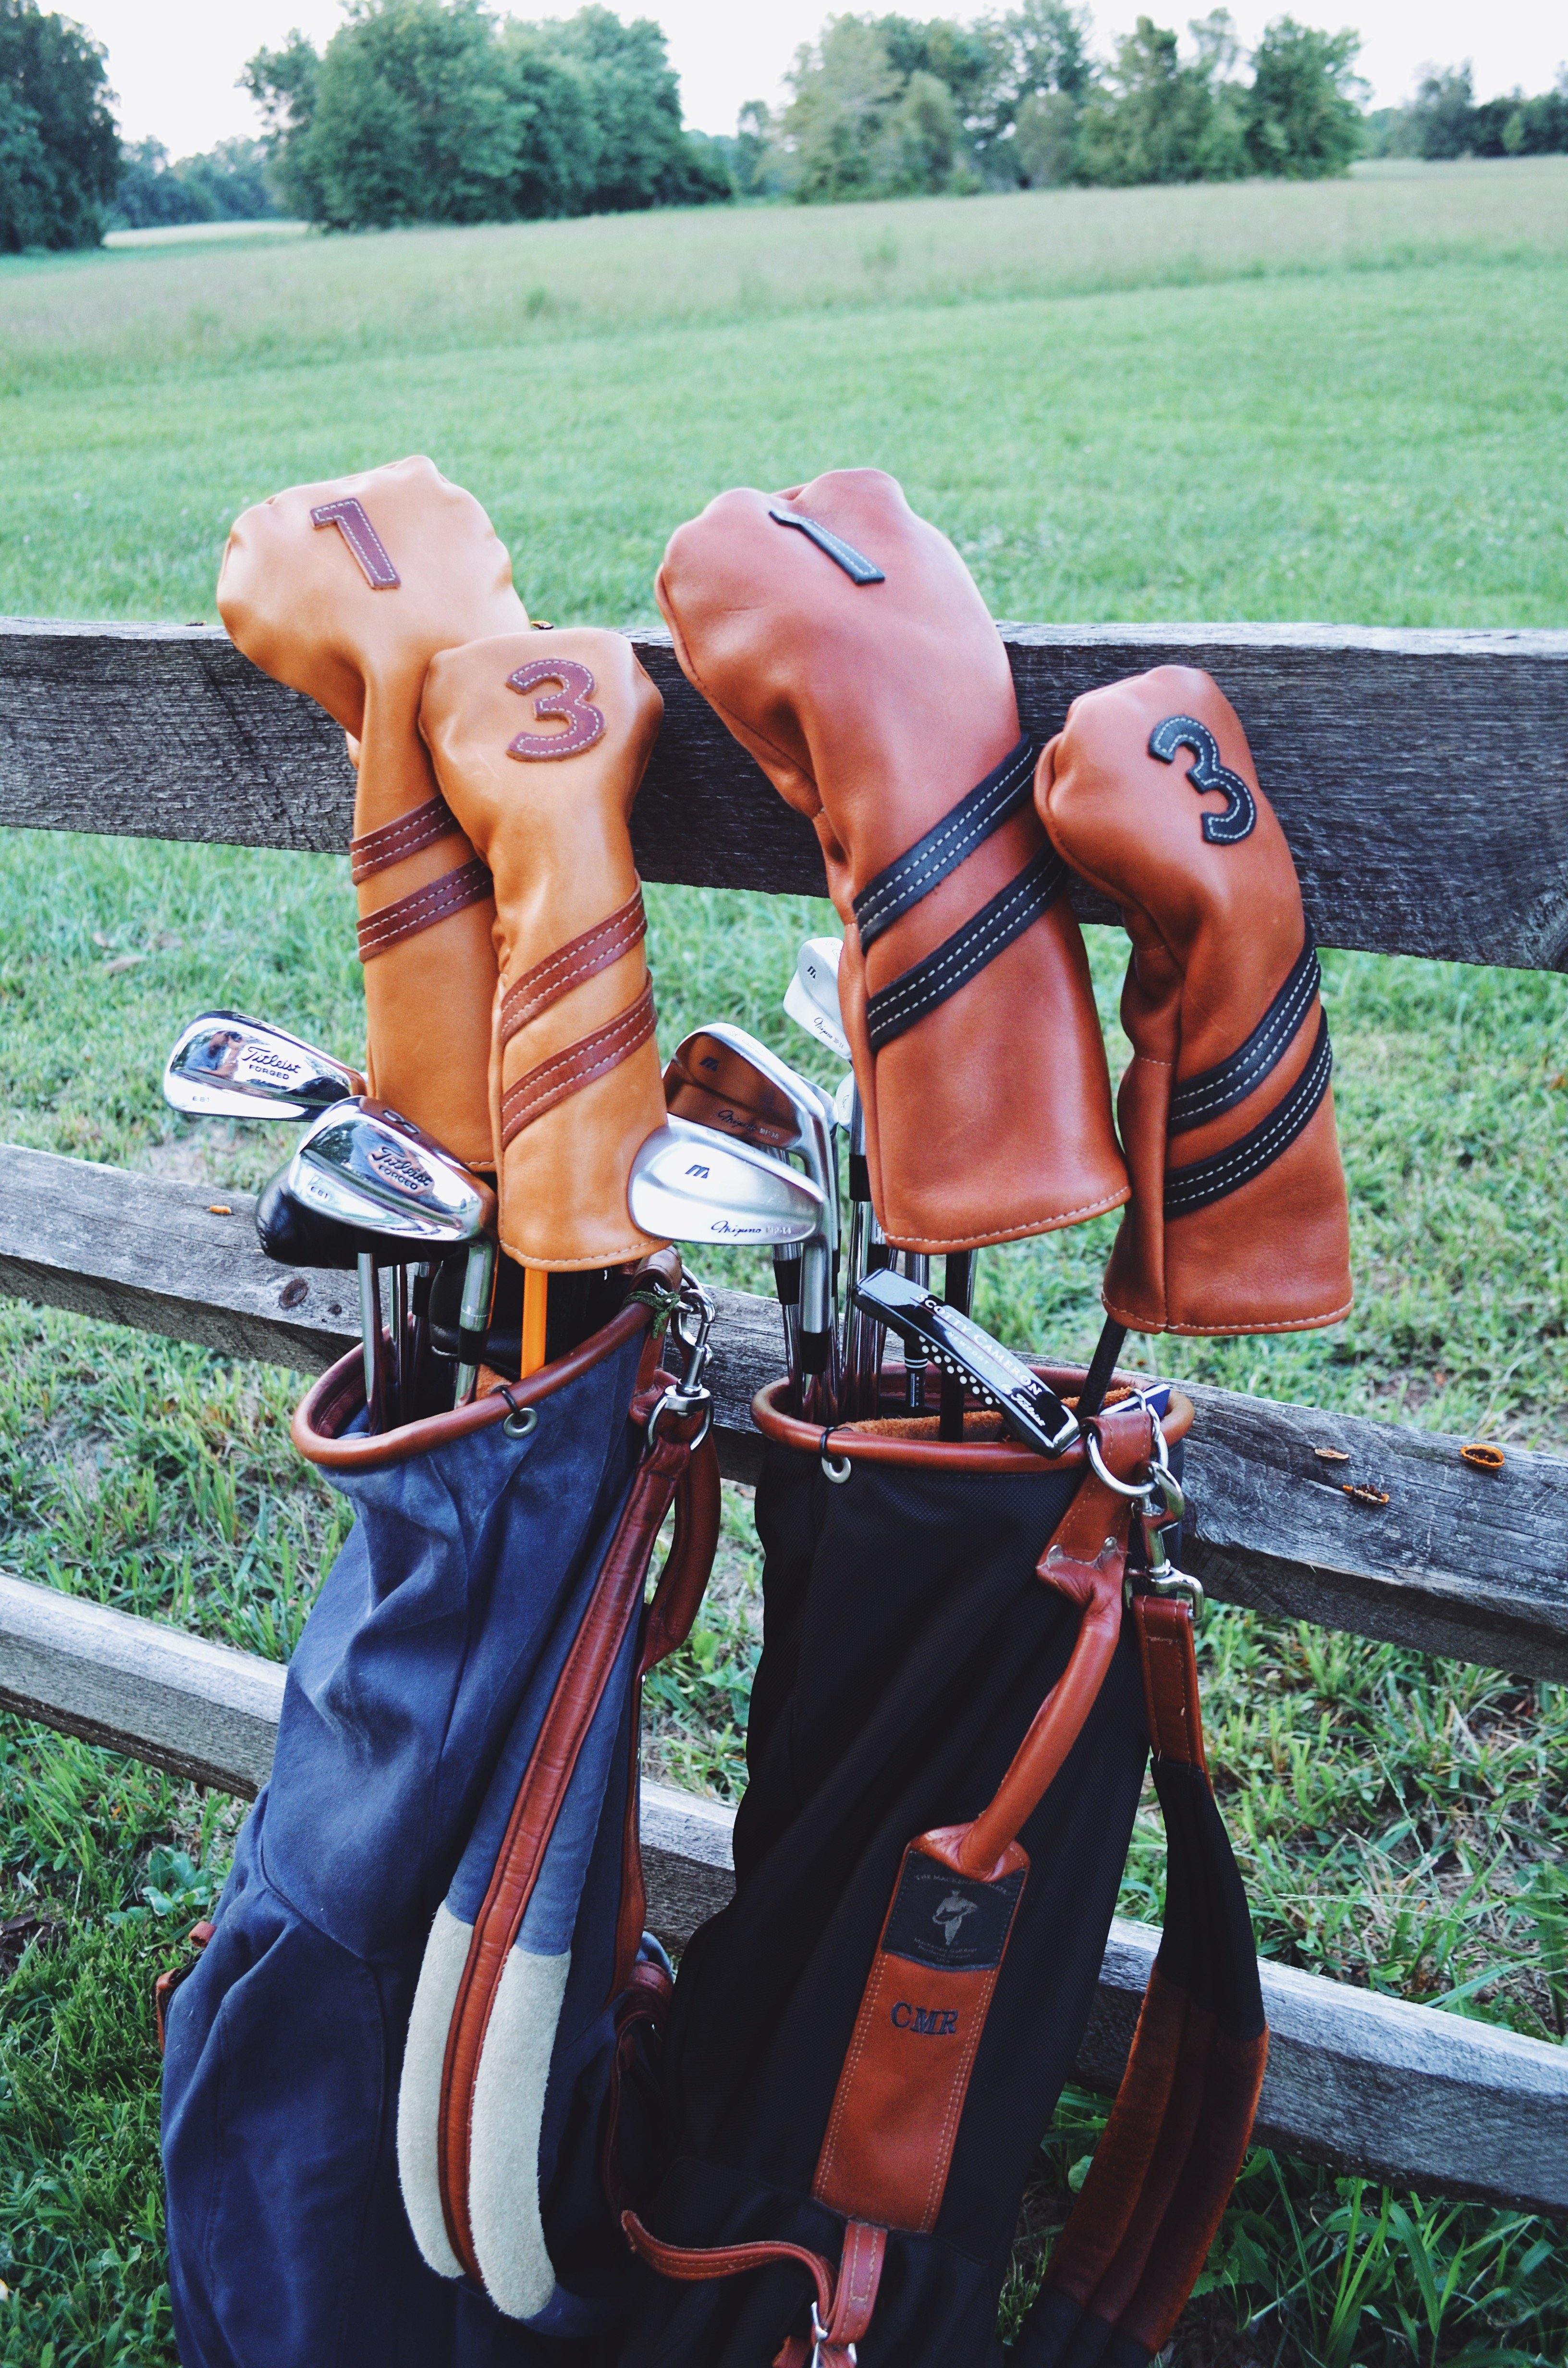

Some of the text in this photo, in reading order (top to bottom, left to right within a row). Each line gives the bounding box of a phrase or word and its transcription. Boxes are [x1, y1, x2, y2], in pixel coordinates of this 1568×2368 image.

[310, 498, 400, 589] 1
[769, 510, 885, 586] 1
[506, 658, 605, 761] 3
[1148, 714, 1257, 846] 3
[241, 1046, 302, 1073] Titleist
[249, 1064, 290, 1080] FORGED
[371, 1147, 433, 1186] Titleist
[379, 1165, 418, 1190] FORGED
[710, 1220, 762, 1237] Mizuno
[916, 1293, 973, 1334] SCOTTY
[974, 1334, 1042, 1395] CAMERON
[947, 1331, 989, 1365] NEWPORT
[1010, 1393, 1046, 1427] Titleist
[890, 2001, 959, 2035] CMR
